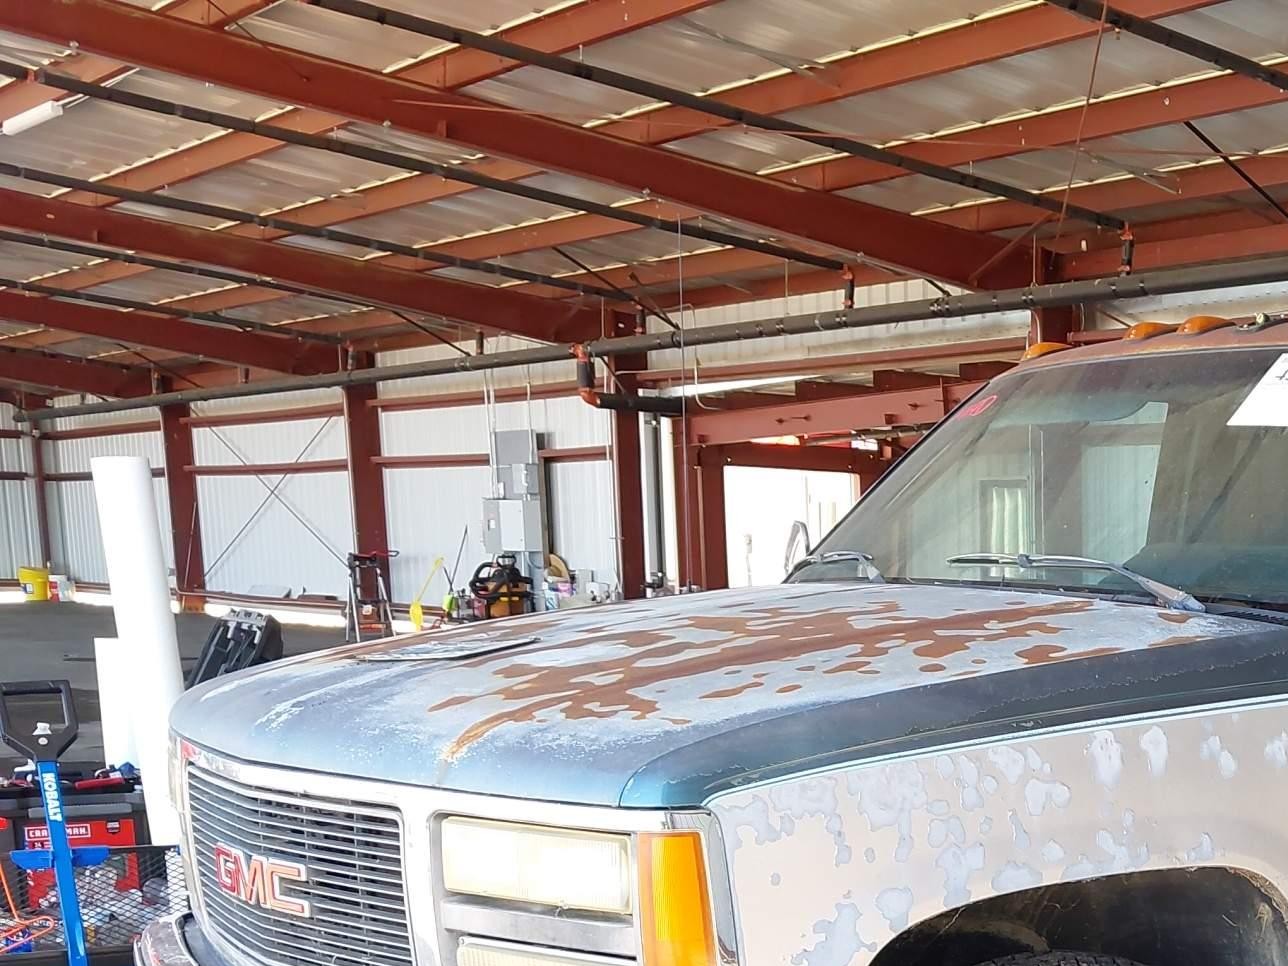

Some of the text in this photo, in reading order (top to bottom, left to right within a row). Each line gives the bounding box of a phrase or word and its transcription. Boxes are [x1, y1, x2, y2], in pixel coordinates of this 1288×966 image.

[41, 772, 63, 822] KOBALT
[28, 827, 88, 838] CRAMAN
[215, 842, 311, 918] GMC
